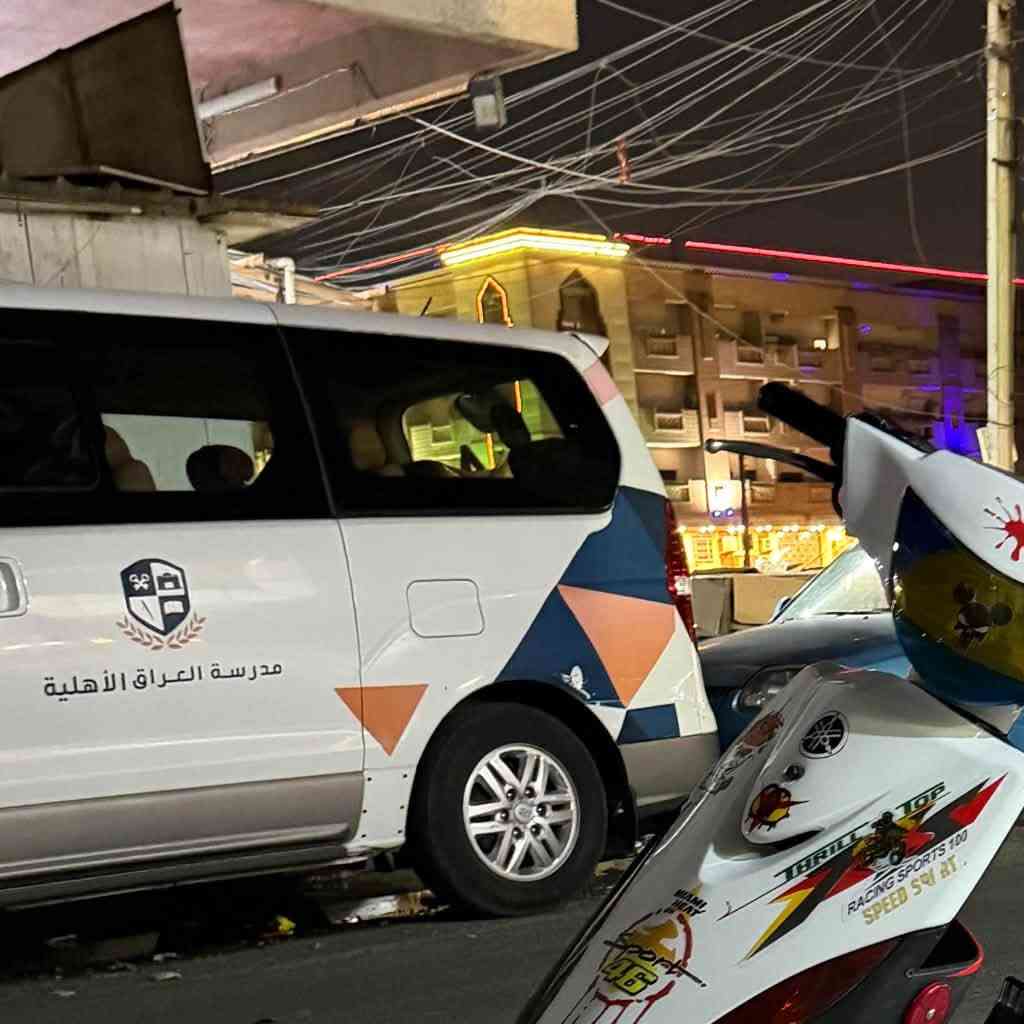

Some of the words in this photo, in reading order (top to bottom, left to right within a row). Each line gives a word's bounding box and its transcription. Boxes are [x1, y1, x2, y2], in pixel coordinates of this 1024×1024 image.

[42, 669, 127, 702] الأهلية
[131, 664, 203, 690] العراق
[210, 662, 283, 681] مدرسة
[774, 825, 863, 882] THRILL
[896, 782, 947, 816] TOP
[847, 876, 895, 915] RACING
[896, 843, 946, 882] SPORTS
[948, 828, 968, 851] 100
[863, 886, 908, 925] SPEED
